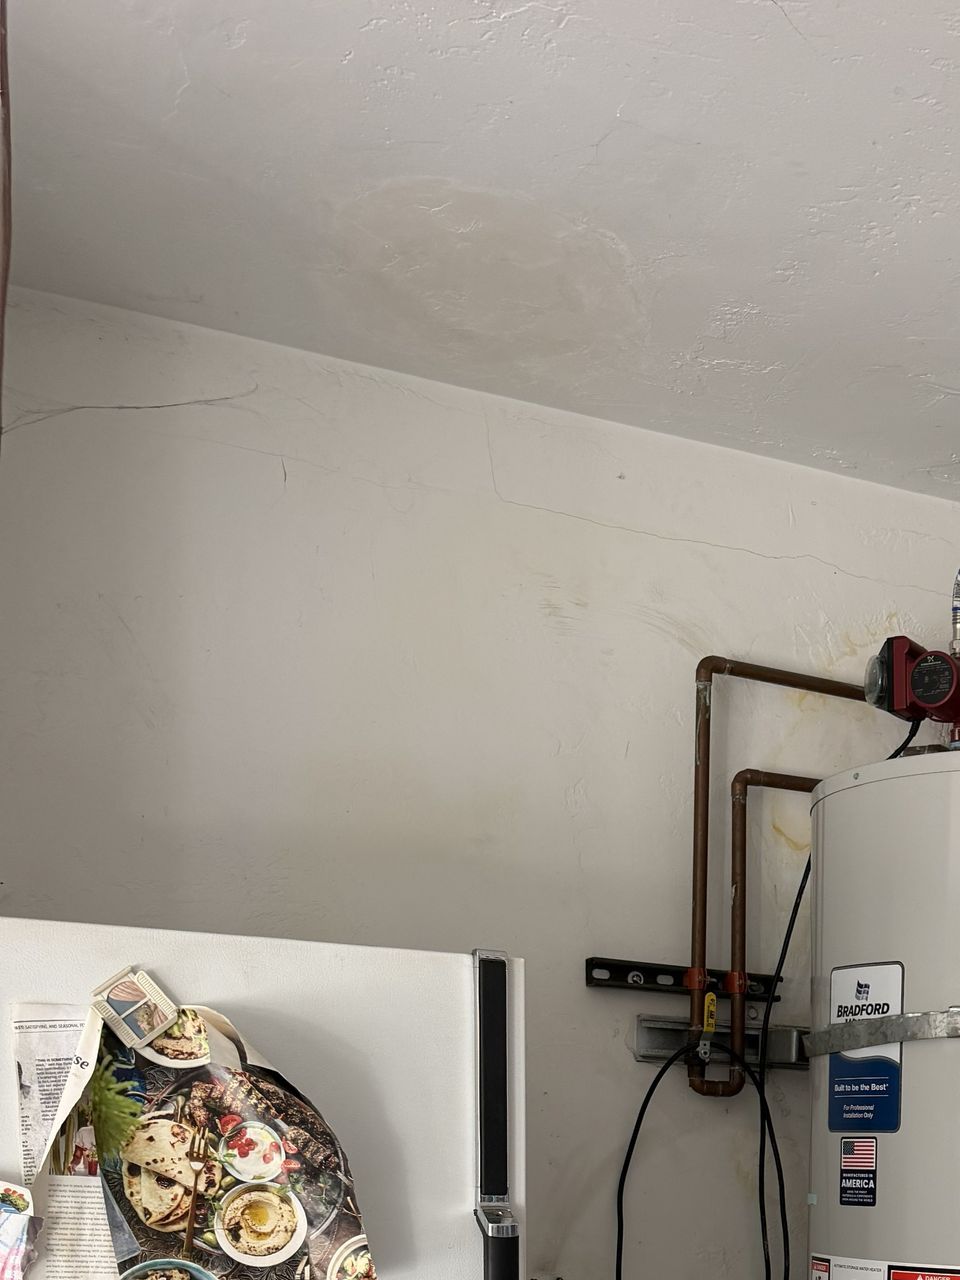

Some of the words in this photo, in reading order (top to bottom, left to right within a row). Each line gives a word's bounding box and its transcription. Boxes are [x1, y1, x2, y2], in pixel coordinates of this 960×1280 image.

[837, 1003, 890, 1018] BRADFORD
[73, 1054, 90, 1070] se
[835, 1084, 845, 1092] Built
[846, 1084, 851, 1092] to
[852, 1084, 860, 1092] be
[860, 1083, 870, 1091] the
[864, 1112, 874, 1120] Only
[841, 1179, 875, 1189] AMERICA
